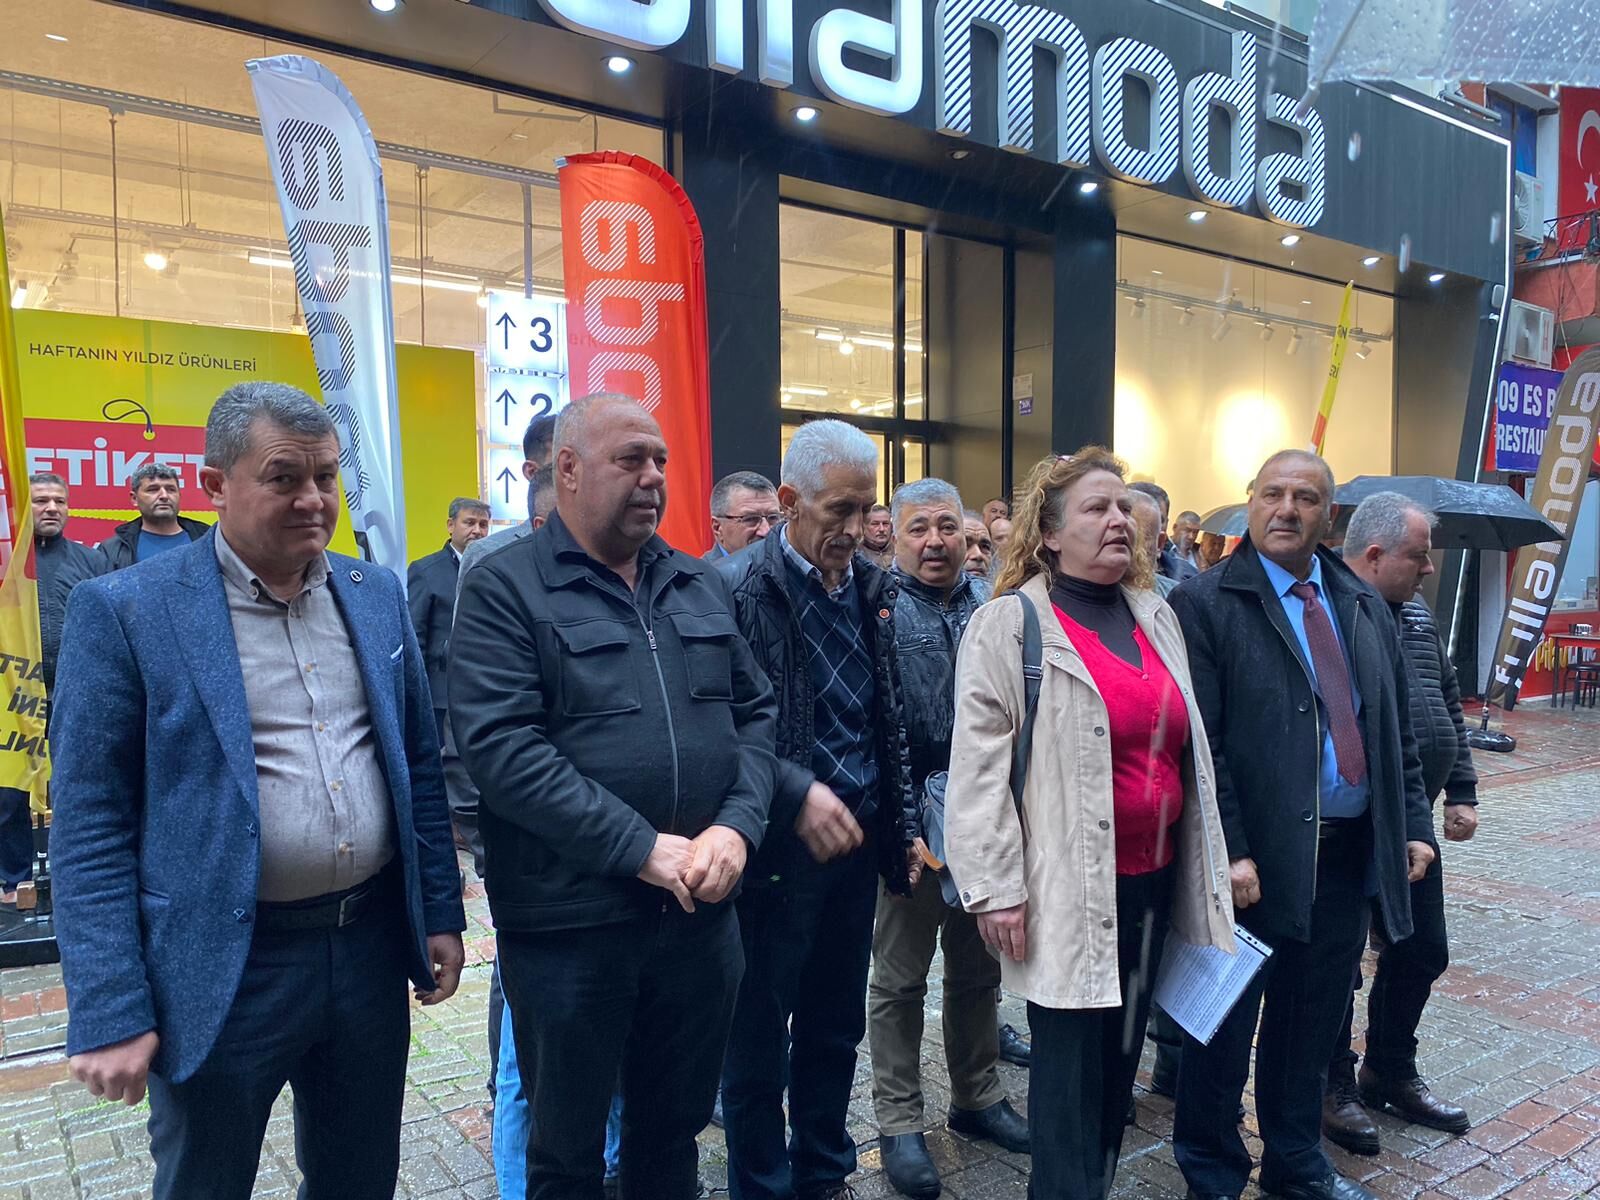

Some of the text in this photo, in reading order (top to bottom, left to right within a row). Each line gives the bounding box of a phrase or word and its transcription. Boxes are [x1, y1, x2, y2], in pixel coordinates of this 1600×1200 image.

[530, 316, 553, 353] 3
[29, 342, 257, 372] HAFTANIN YILDIZ ÜRÜNLERİ
[1499, 379, 1519, 414] 09
[1522, 383, 1543, 417] ES
[25, 437, 206, 488] ETİKET
